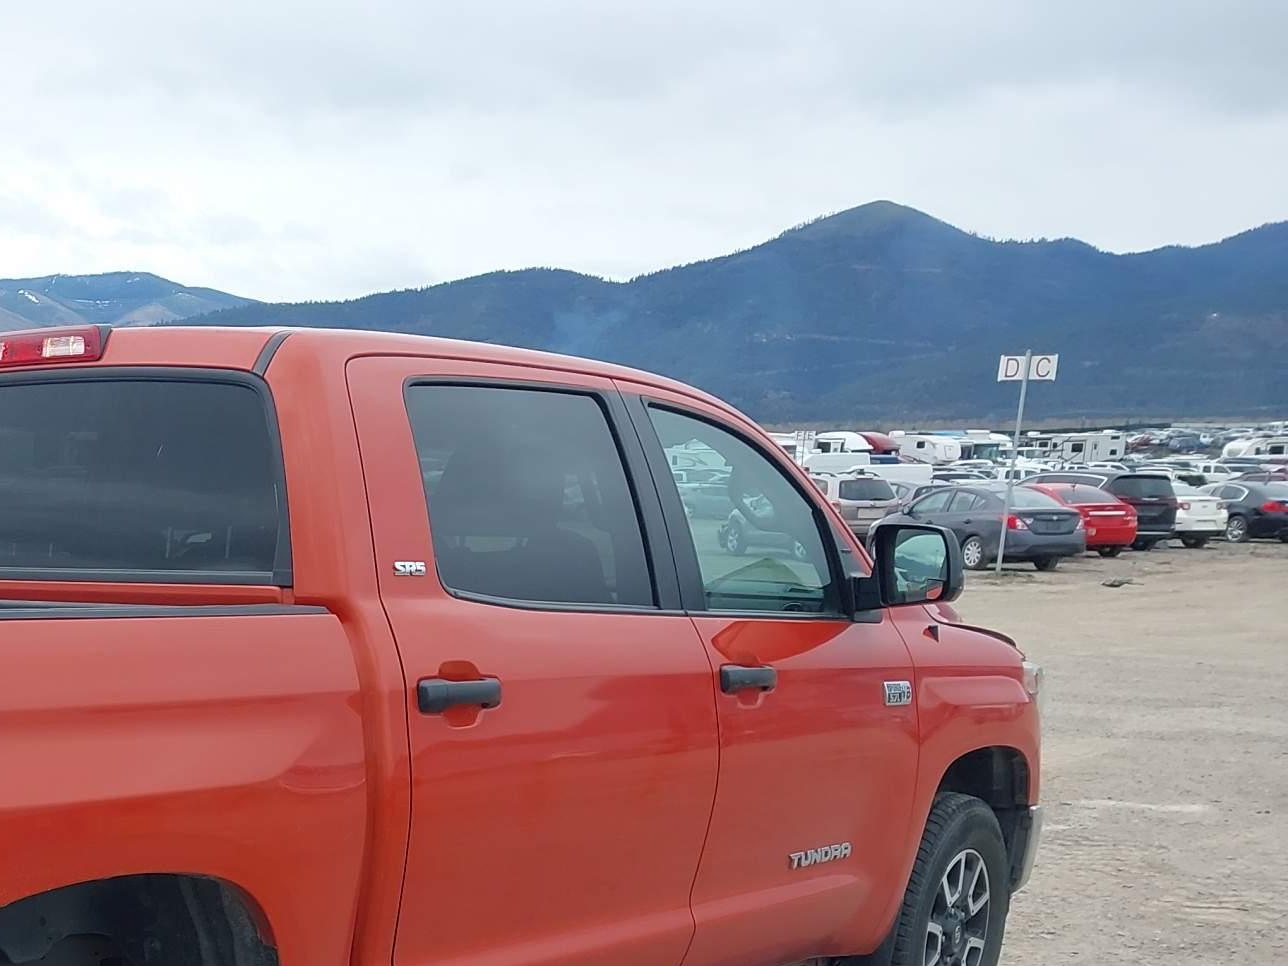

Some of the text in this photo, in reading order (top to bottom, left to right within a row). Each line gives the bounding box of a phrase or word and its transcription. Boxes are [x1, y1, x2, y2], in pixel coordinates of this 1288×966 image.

[1004, 357, 1051, 378] D C
[394, 560, 426, 576] SR5
[789, 841, 852, 870] TUNDRA
